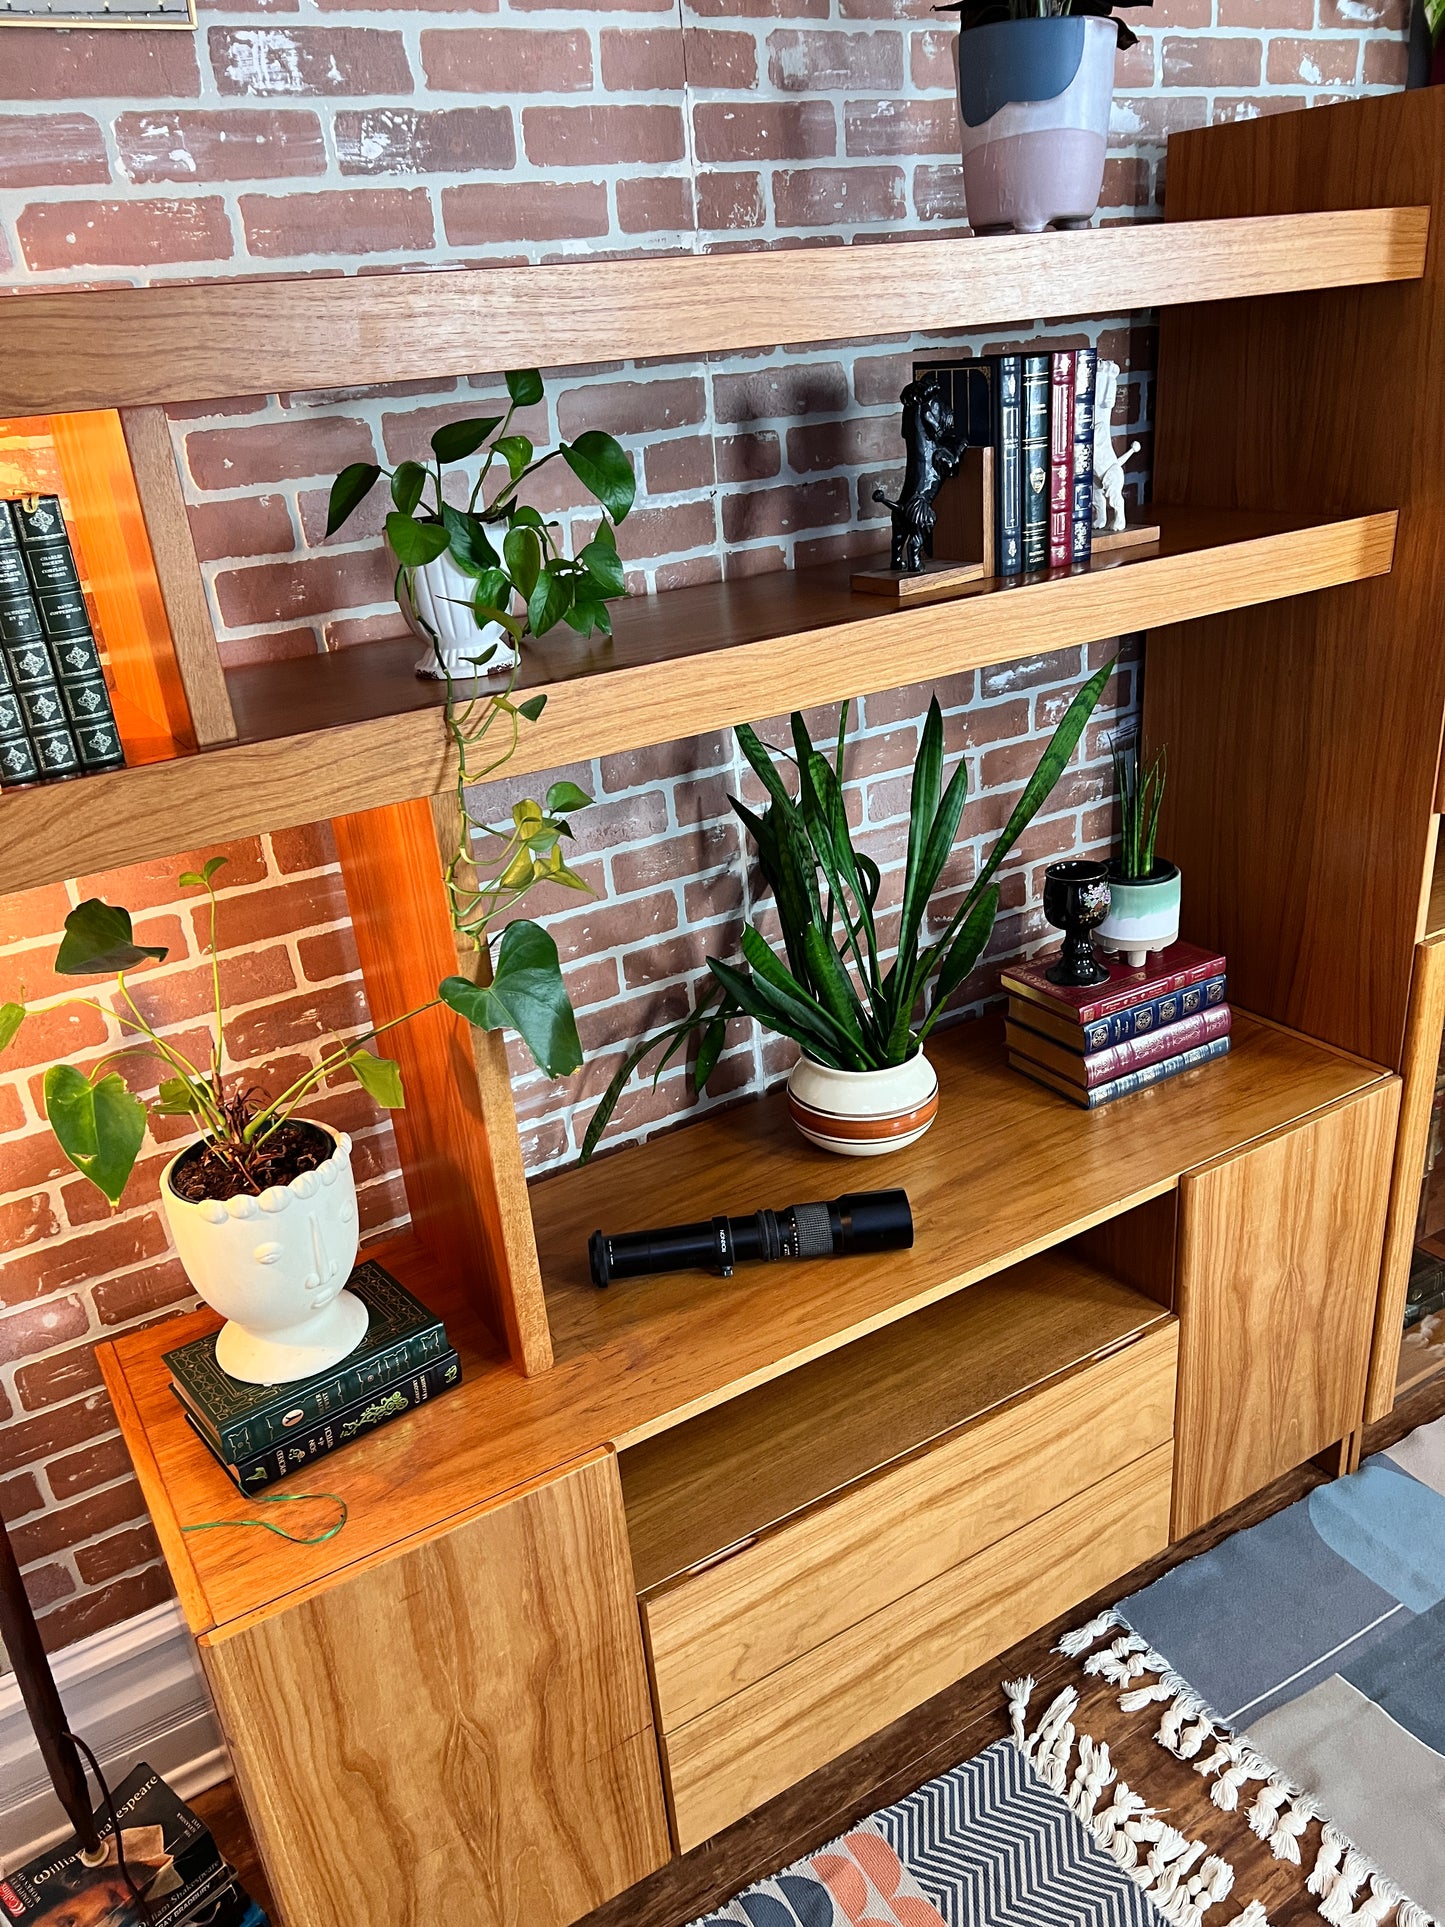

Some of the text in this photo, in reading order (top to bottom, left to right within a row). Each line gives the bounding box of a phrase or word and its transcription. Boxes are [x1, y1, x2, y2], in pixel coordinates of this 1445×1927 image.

[308, 1438, 317, 1454] SON
[324, 1425, 334, 1449] WITCH
[276, 1449, 287, 1476] WICKED
[170, 1860, 220, 1905] Shakespeare
[173, 1882, 211, 1918] BRADBURY
